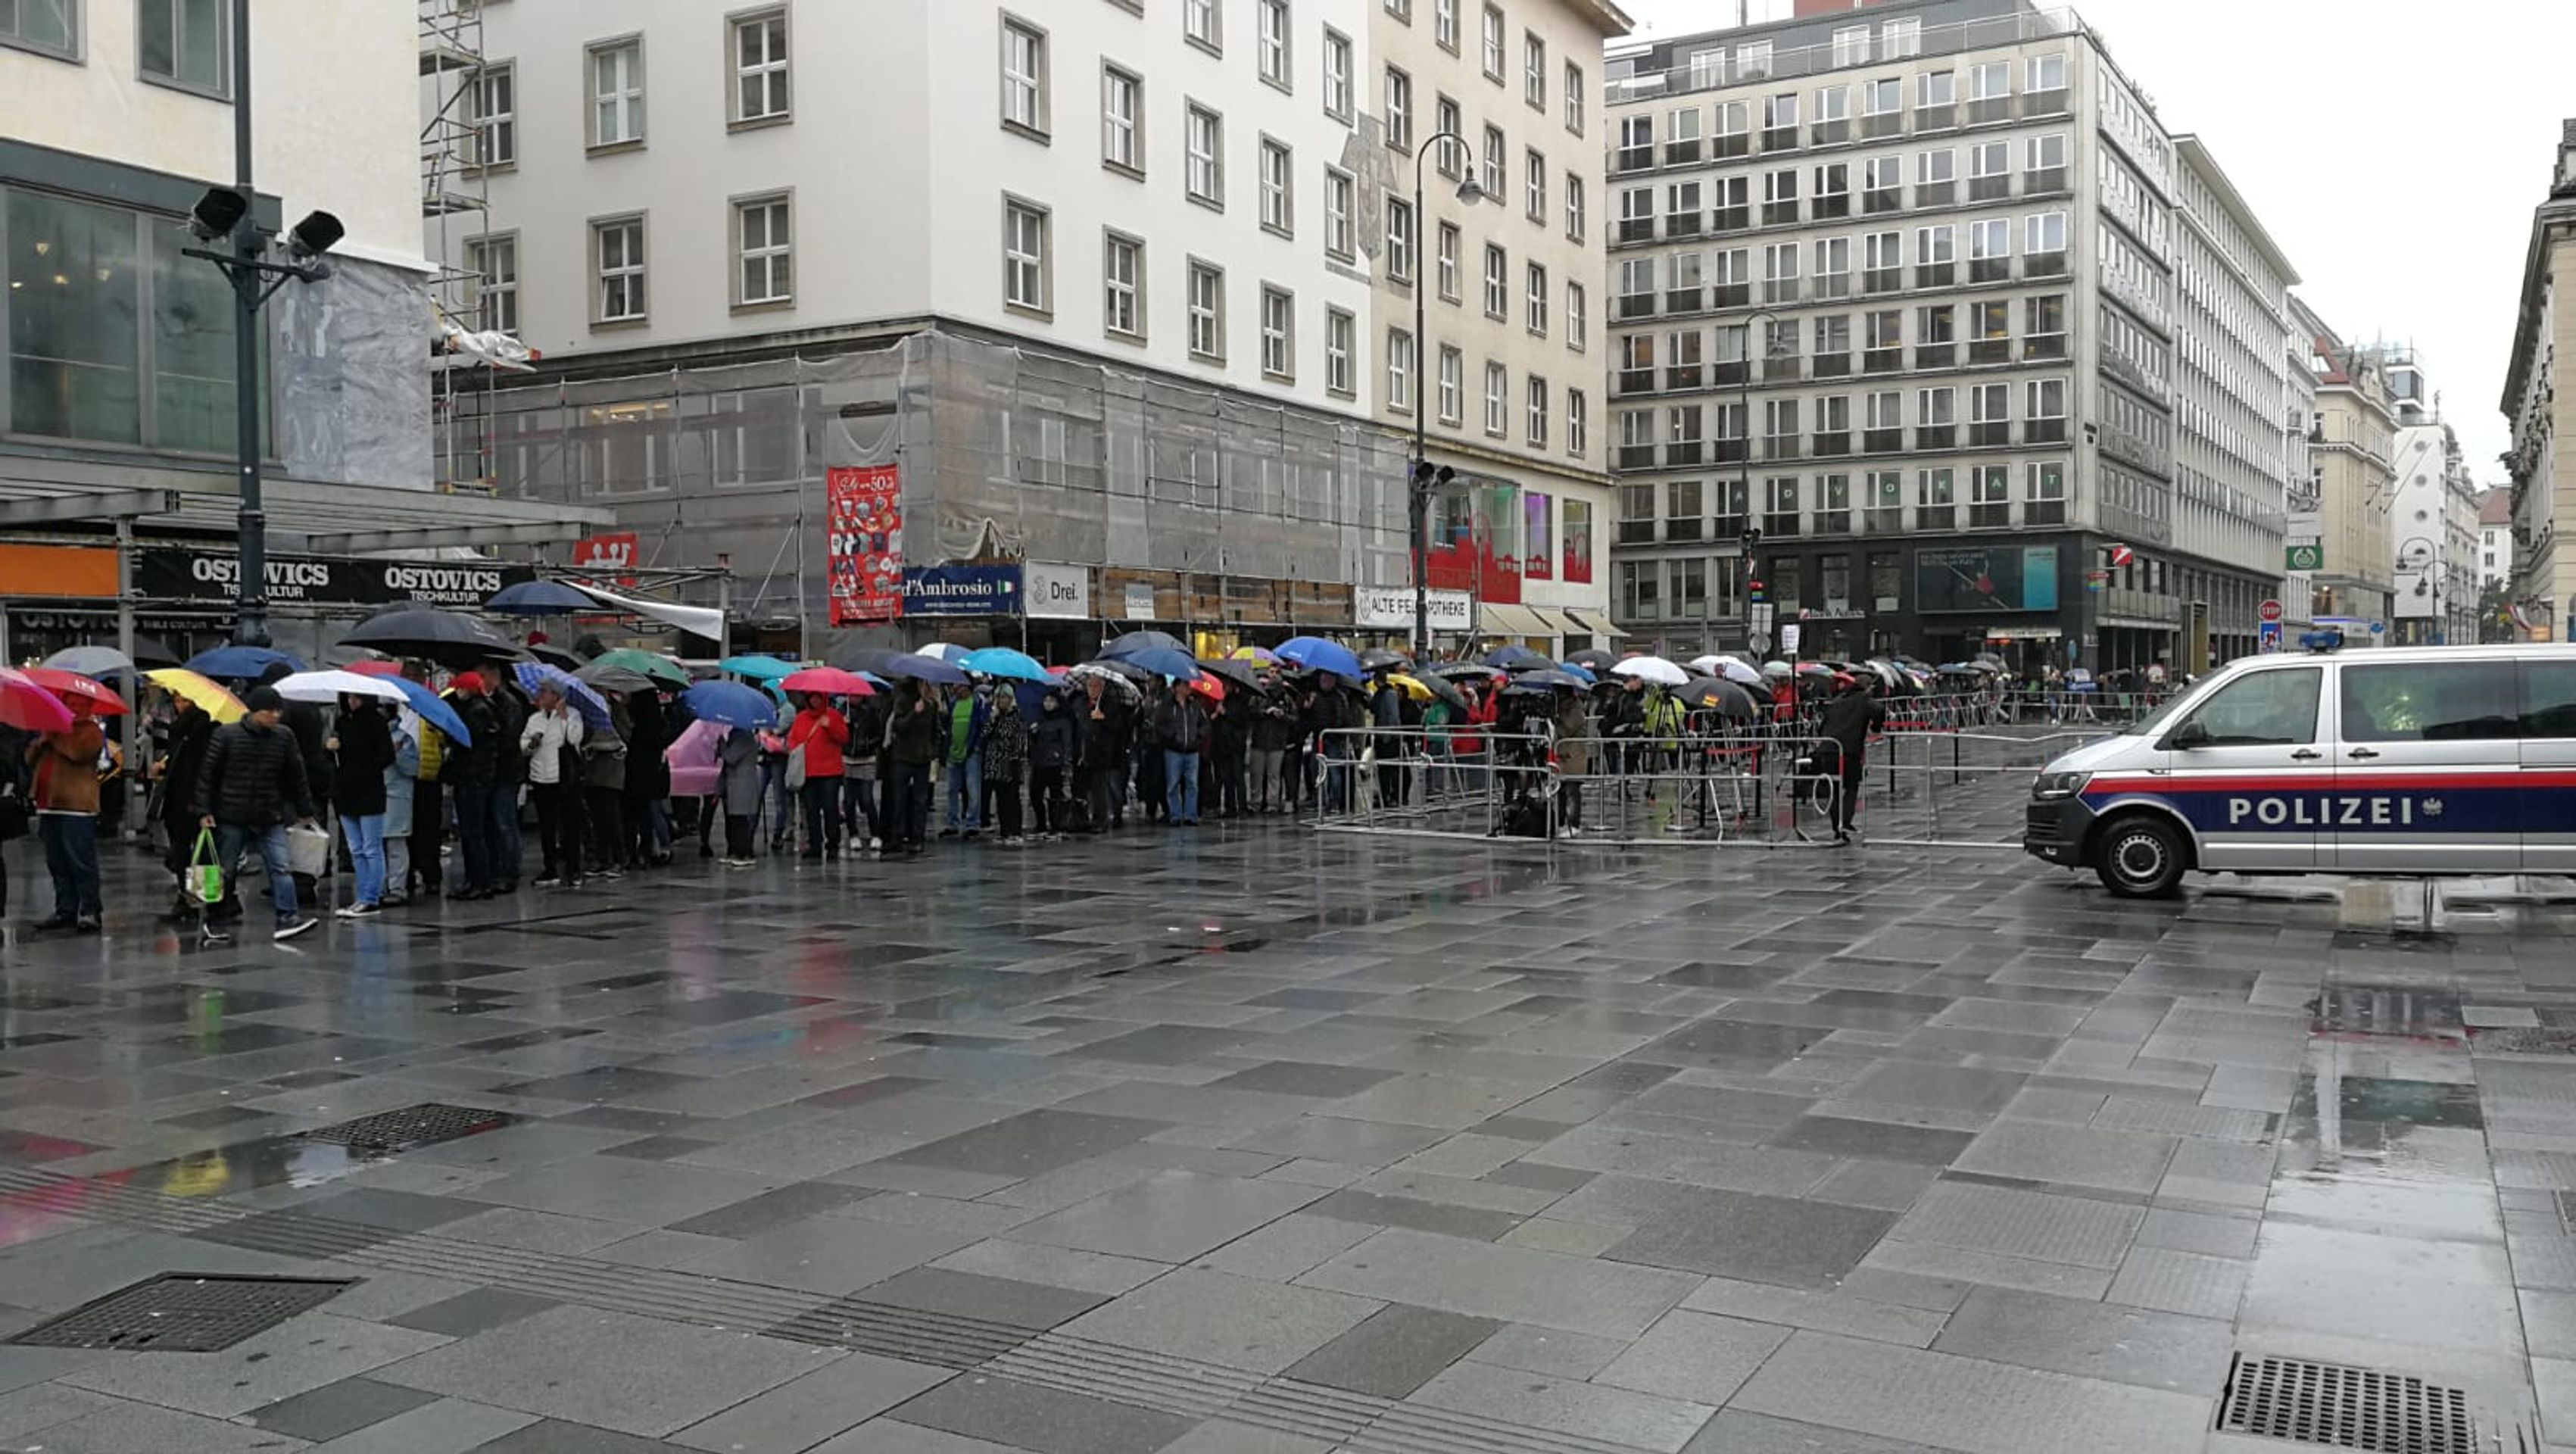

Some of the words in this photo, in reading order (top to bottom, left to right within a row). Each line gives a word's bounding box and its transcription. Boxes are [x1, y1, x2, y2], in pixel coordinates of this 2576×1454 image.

[192, 557, 329, 586] OSTVICS
[385, 568, 501, 591] OSTOVICS
[221, 582, 304, 598] TISULTUR
[410, 591, 479, 602] TISCHKULTUR
[901, 577, 992, 597] d'Ambrosio
[1050, 581, 1079, 601] Drei.
[1372, 597, 1395, 613] ALTE
[2261, 606, 2281, 615] STOP
[2228, 797, 2412, 825] POLIZEI
